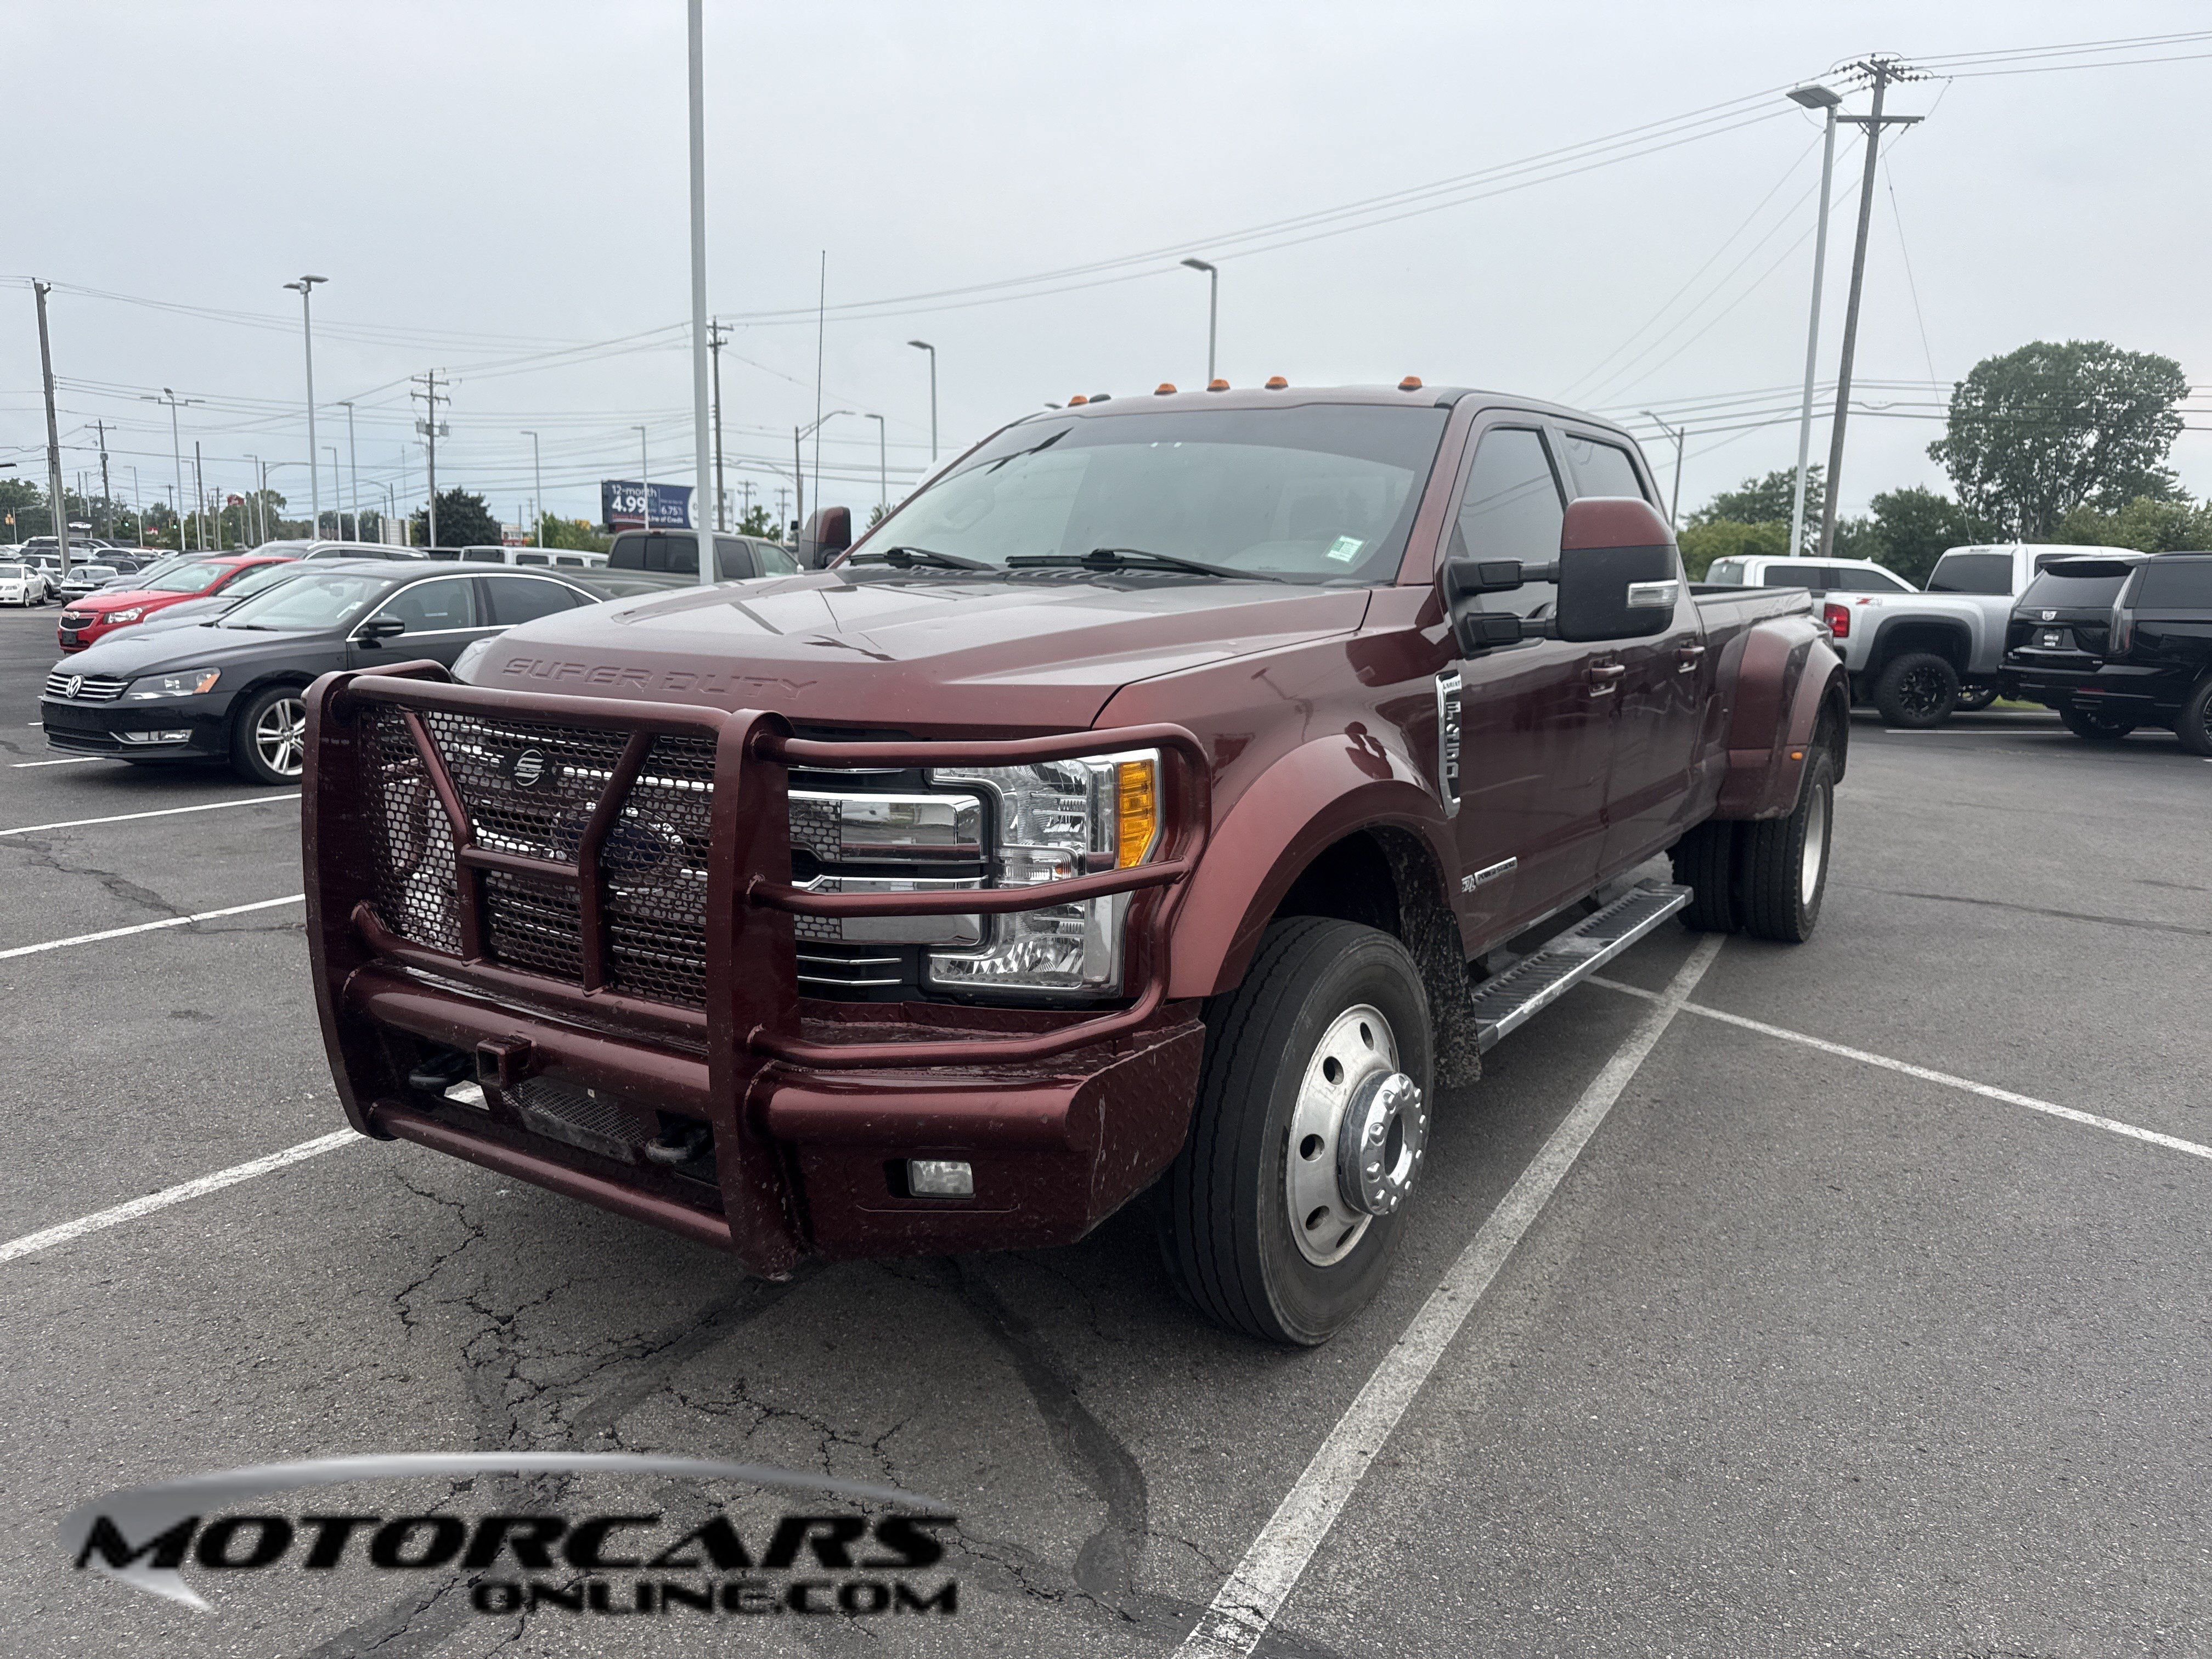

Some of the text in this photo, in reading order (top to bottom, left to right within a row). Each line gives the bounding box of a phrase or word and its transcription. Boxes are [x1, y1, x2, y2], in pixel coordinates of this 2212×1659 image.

[612, 495, 646, 514] 4.99
[501, 657, 818, 701] SUPER DUTY
